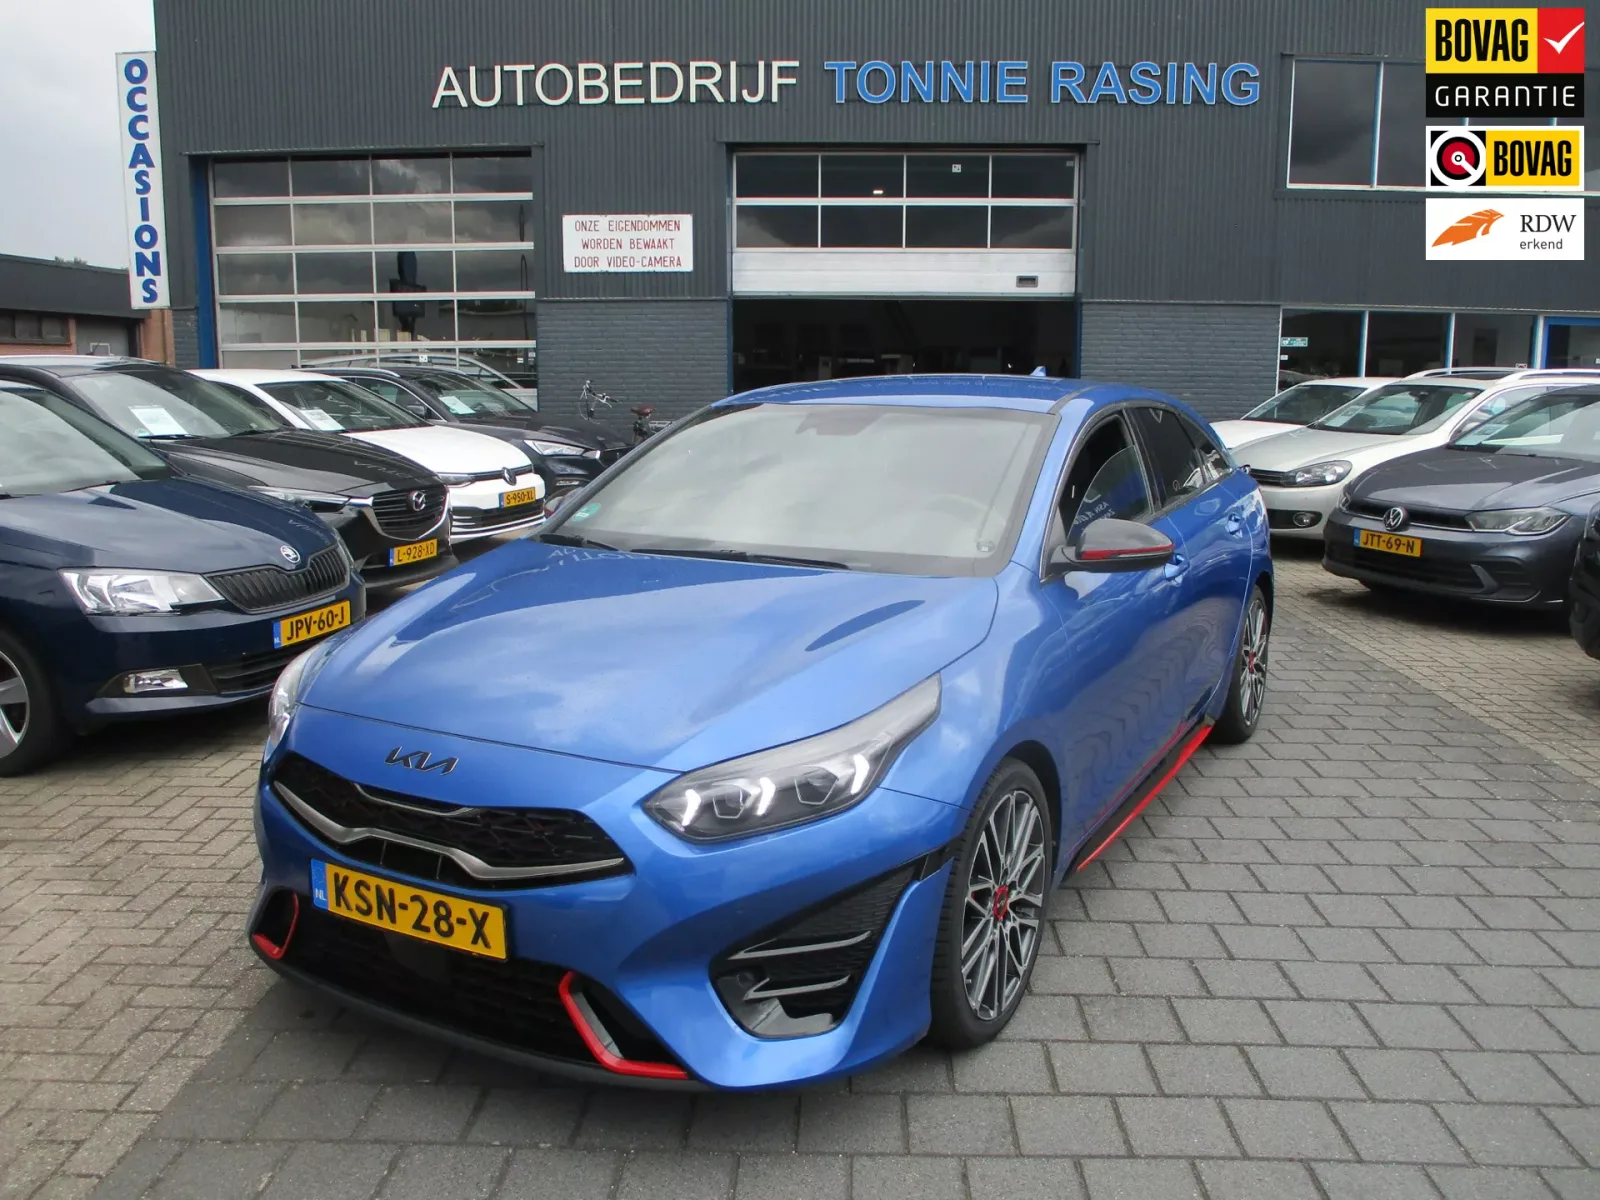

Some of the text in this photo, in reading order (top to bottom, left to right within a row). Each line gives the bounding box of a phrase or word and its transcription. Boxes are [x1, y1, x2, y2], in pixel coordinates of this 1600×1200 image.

[431, 60, 1261, 109] AUTOBEDRIJF TONNIE RASING
[124, 58, 161, 304] OCCASIONS
[574, 219, 681, 232] ONZE EIGENDOMMEN
[581, 237, 675, 250] WORDEN BEWAAKT
[574, 255, 682, 268] DOOR VIDEO-CAMERA
[396, 541, 435, 563] L-928-XD
[1362, 533, 1415, 554] JTT-69-N
[286, 606, 345, 641] JPV-60-J
[384, 746, 459, 775] KIA
[333, 871, 492, 950] KSN-28-X
